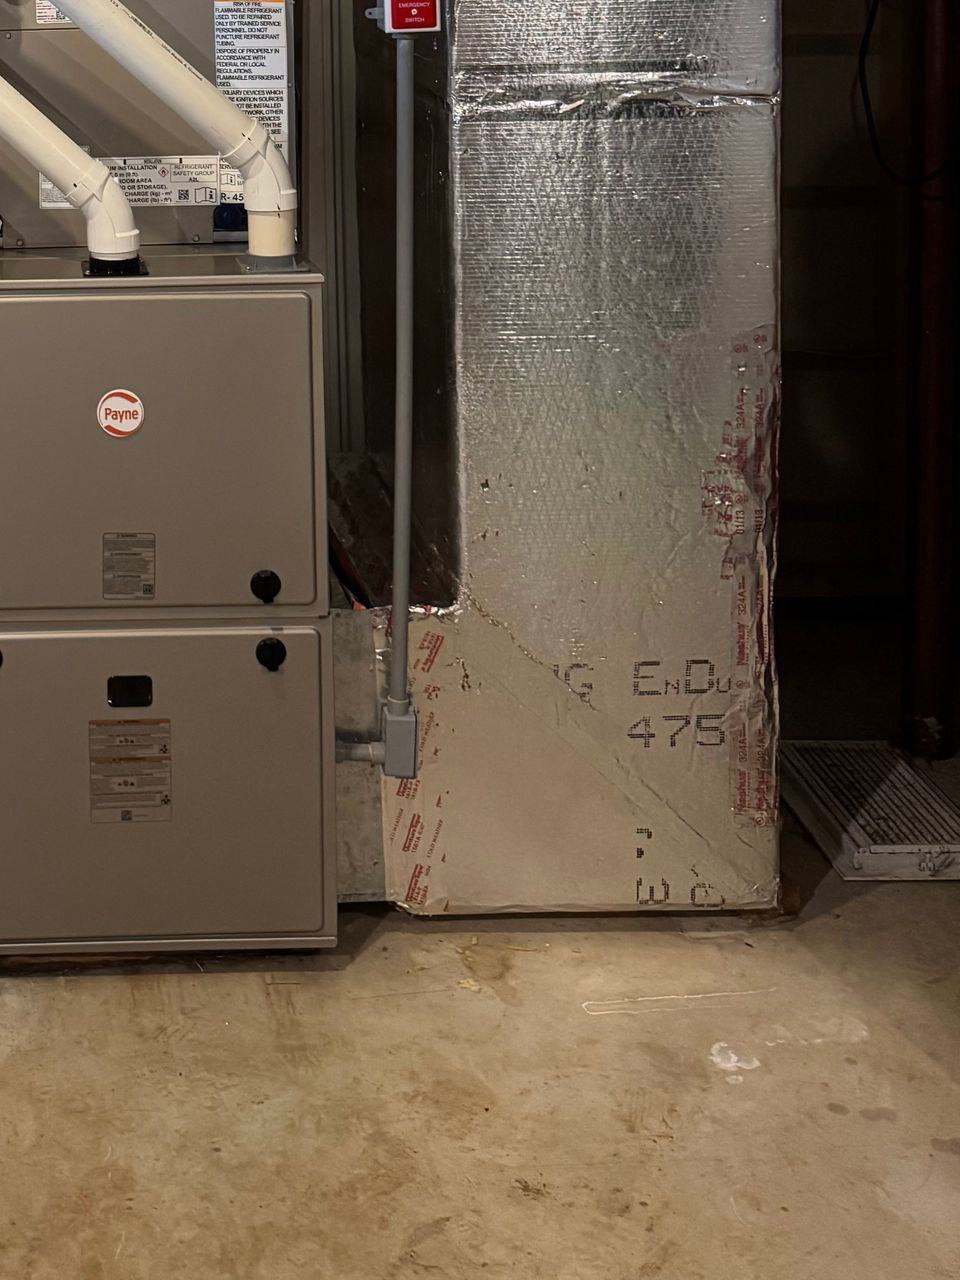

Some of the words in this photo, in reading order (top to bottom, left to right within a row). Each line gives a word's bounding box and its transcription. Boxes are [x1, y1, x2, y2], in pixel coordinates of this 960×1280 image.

[104, 408, 139, 422] Payne
[736, 403, 745, 429] 324A
[736, 510, 745, 534] 01/13
[737, 588, 747, 615] 324A
[627, 714, 726, 749] 475
[738, 734, 747, 762] 324A
